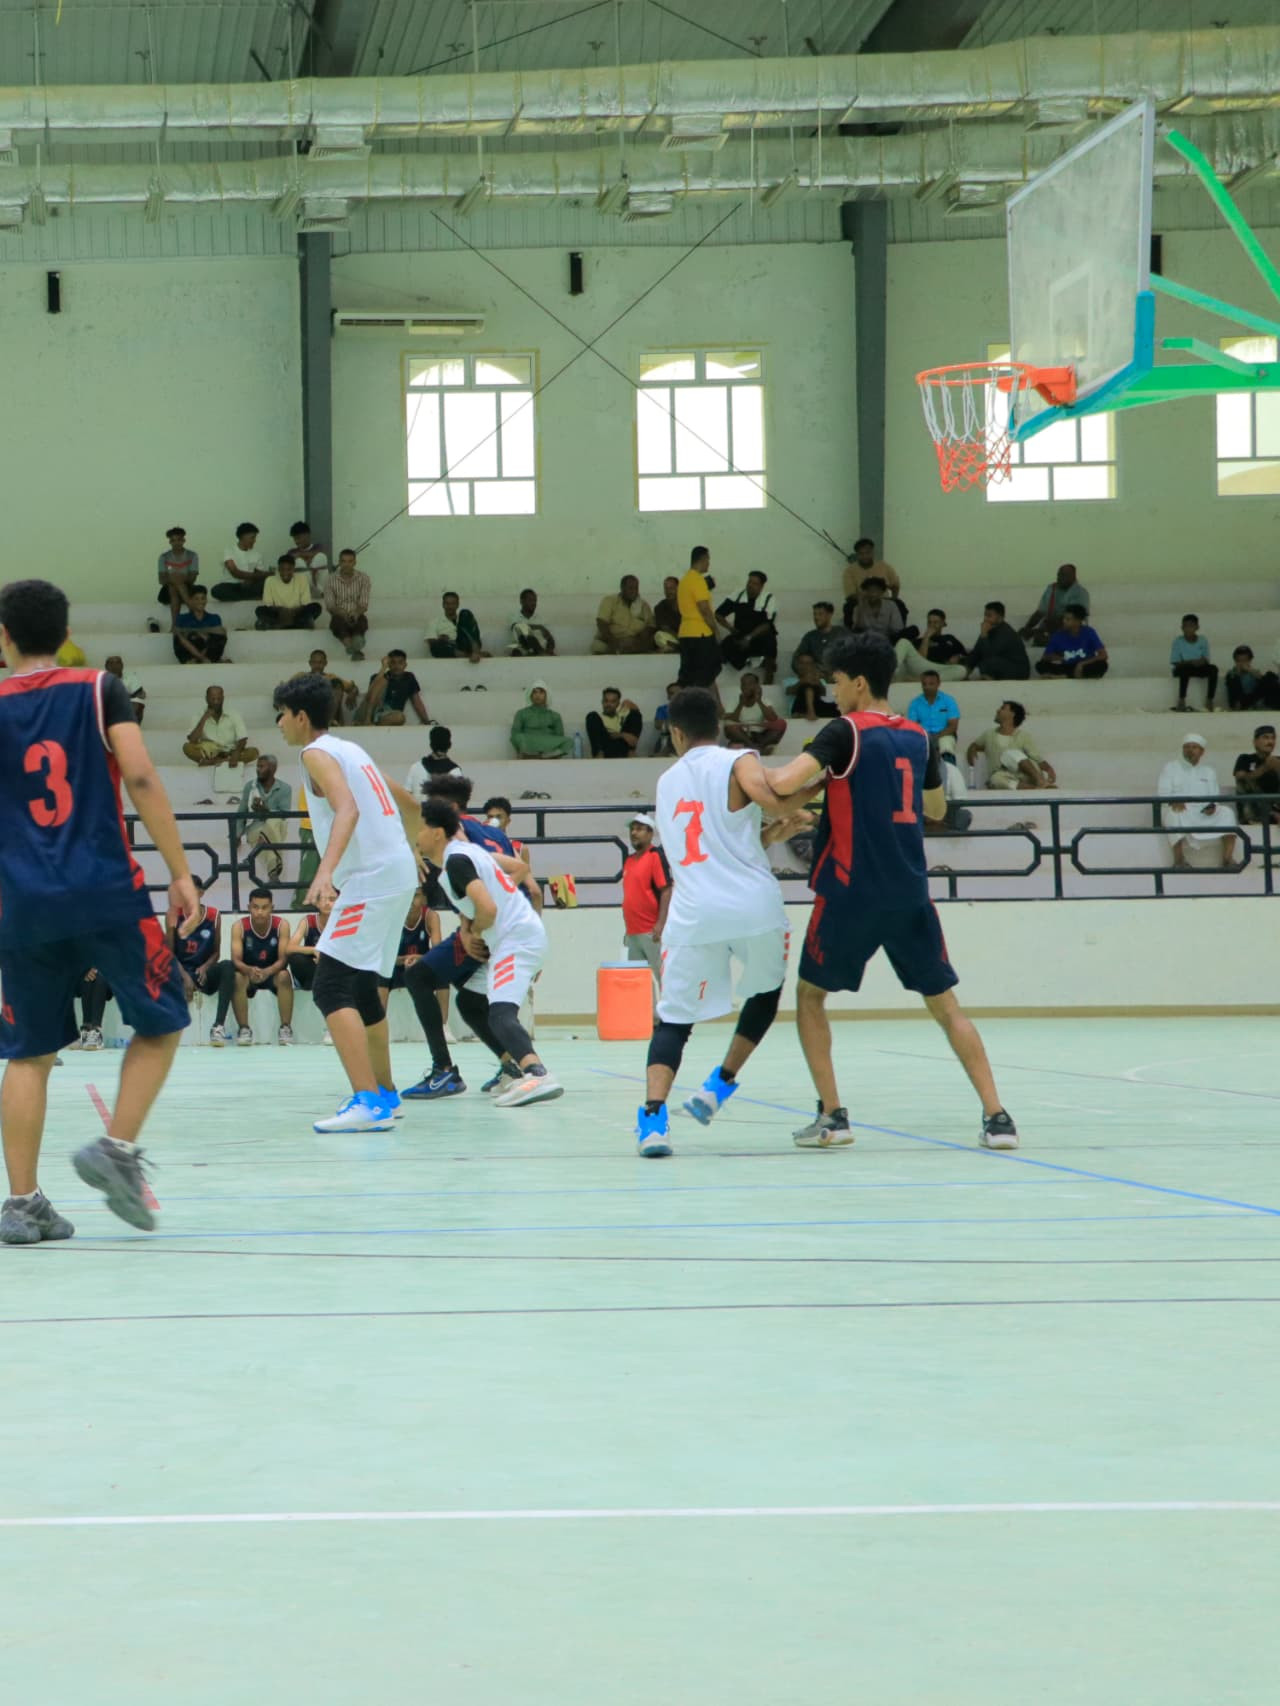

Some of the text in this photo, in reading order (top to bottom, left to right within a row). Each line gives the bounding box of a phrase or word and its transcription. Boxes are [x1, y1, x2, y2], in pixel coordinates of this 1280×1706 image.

[24, 740, 73, 827] 3
[361, 765, 395, 816] 11
[893, 757, 917, 824] 1
[672, 798, 710, 867] 7
[699, 979, 708, 1001] 7
